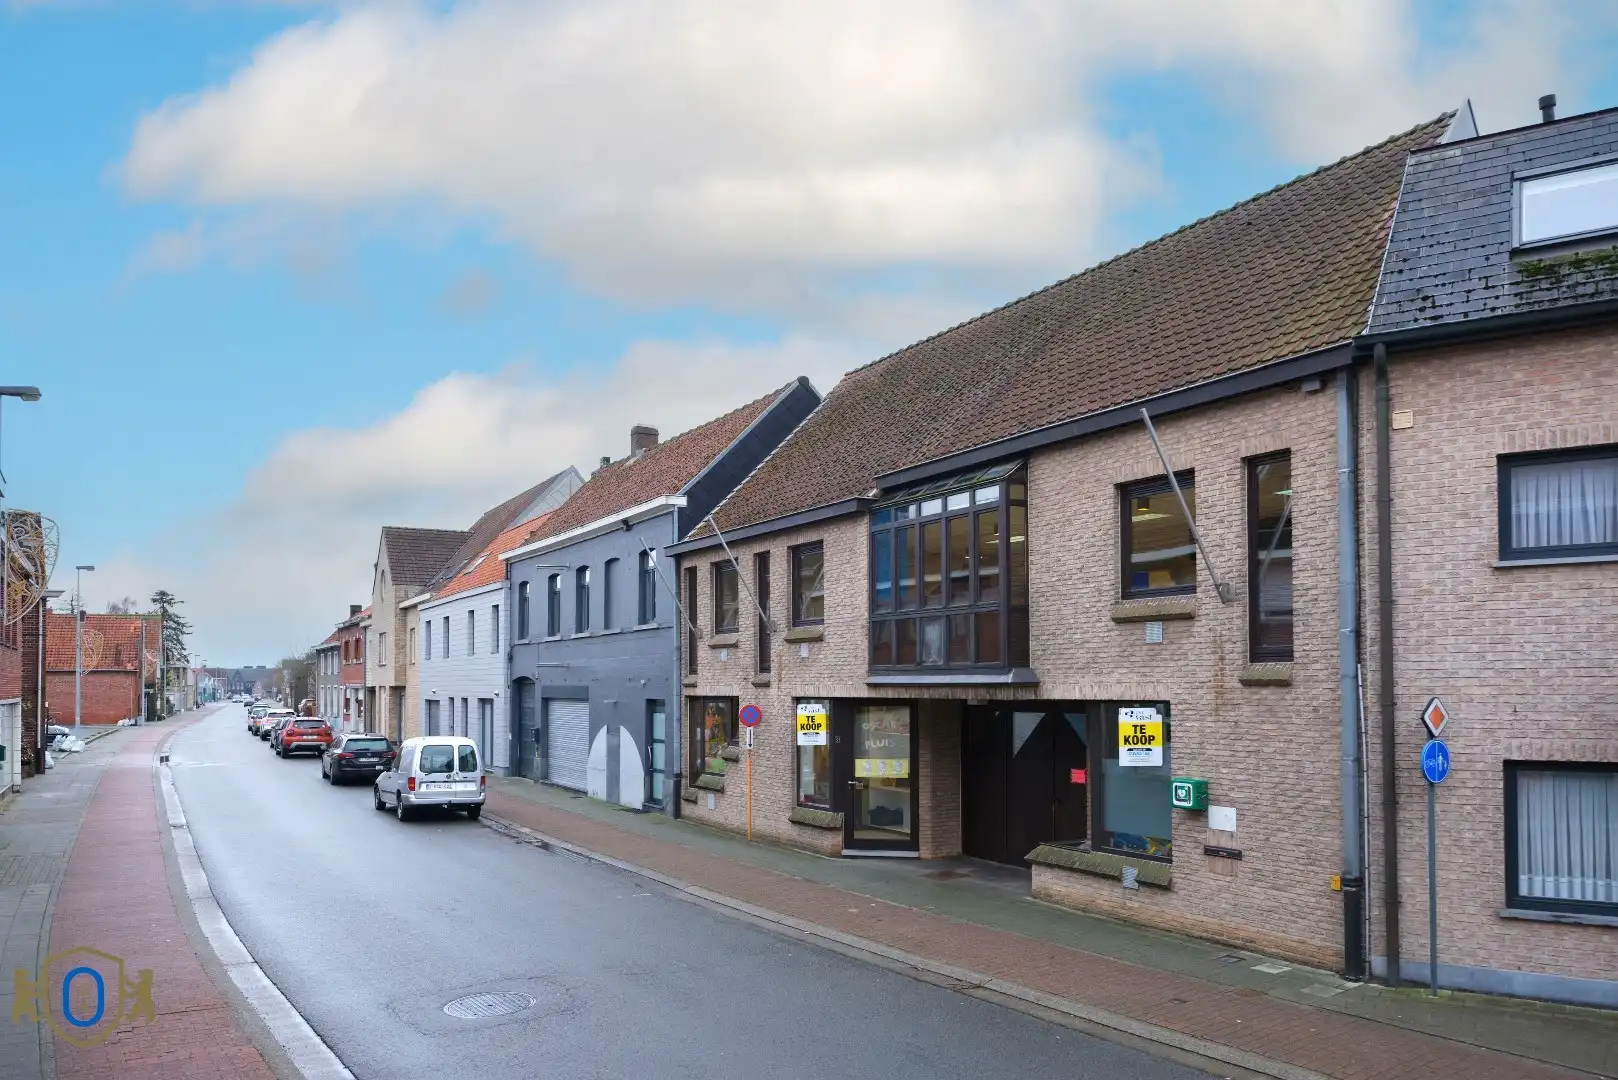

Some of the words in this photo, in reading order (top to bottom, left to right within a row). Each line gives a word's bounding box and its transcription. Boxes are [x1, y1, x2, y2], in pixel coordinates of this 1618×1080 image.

[800, 723, 822, 731] KOOP
[1132, 724, 1146, 735] TE
[1123, 735, 1156, 745] KOOP
